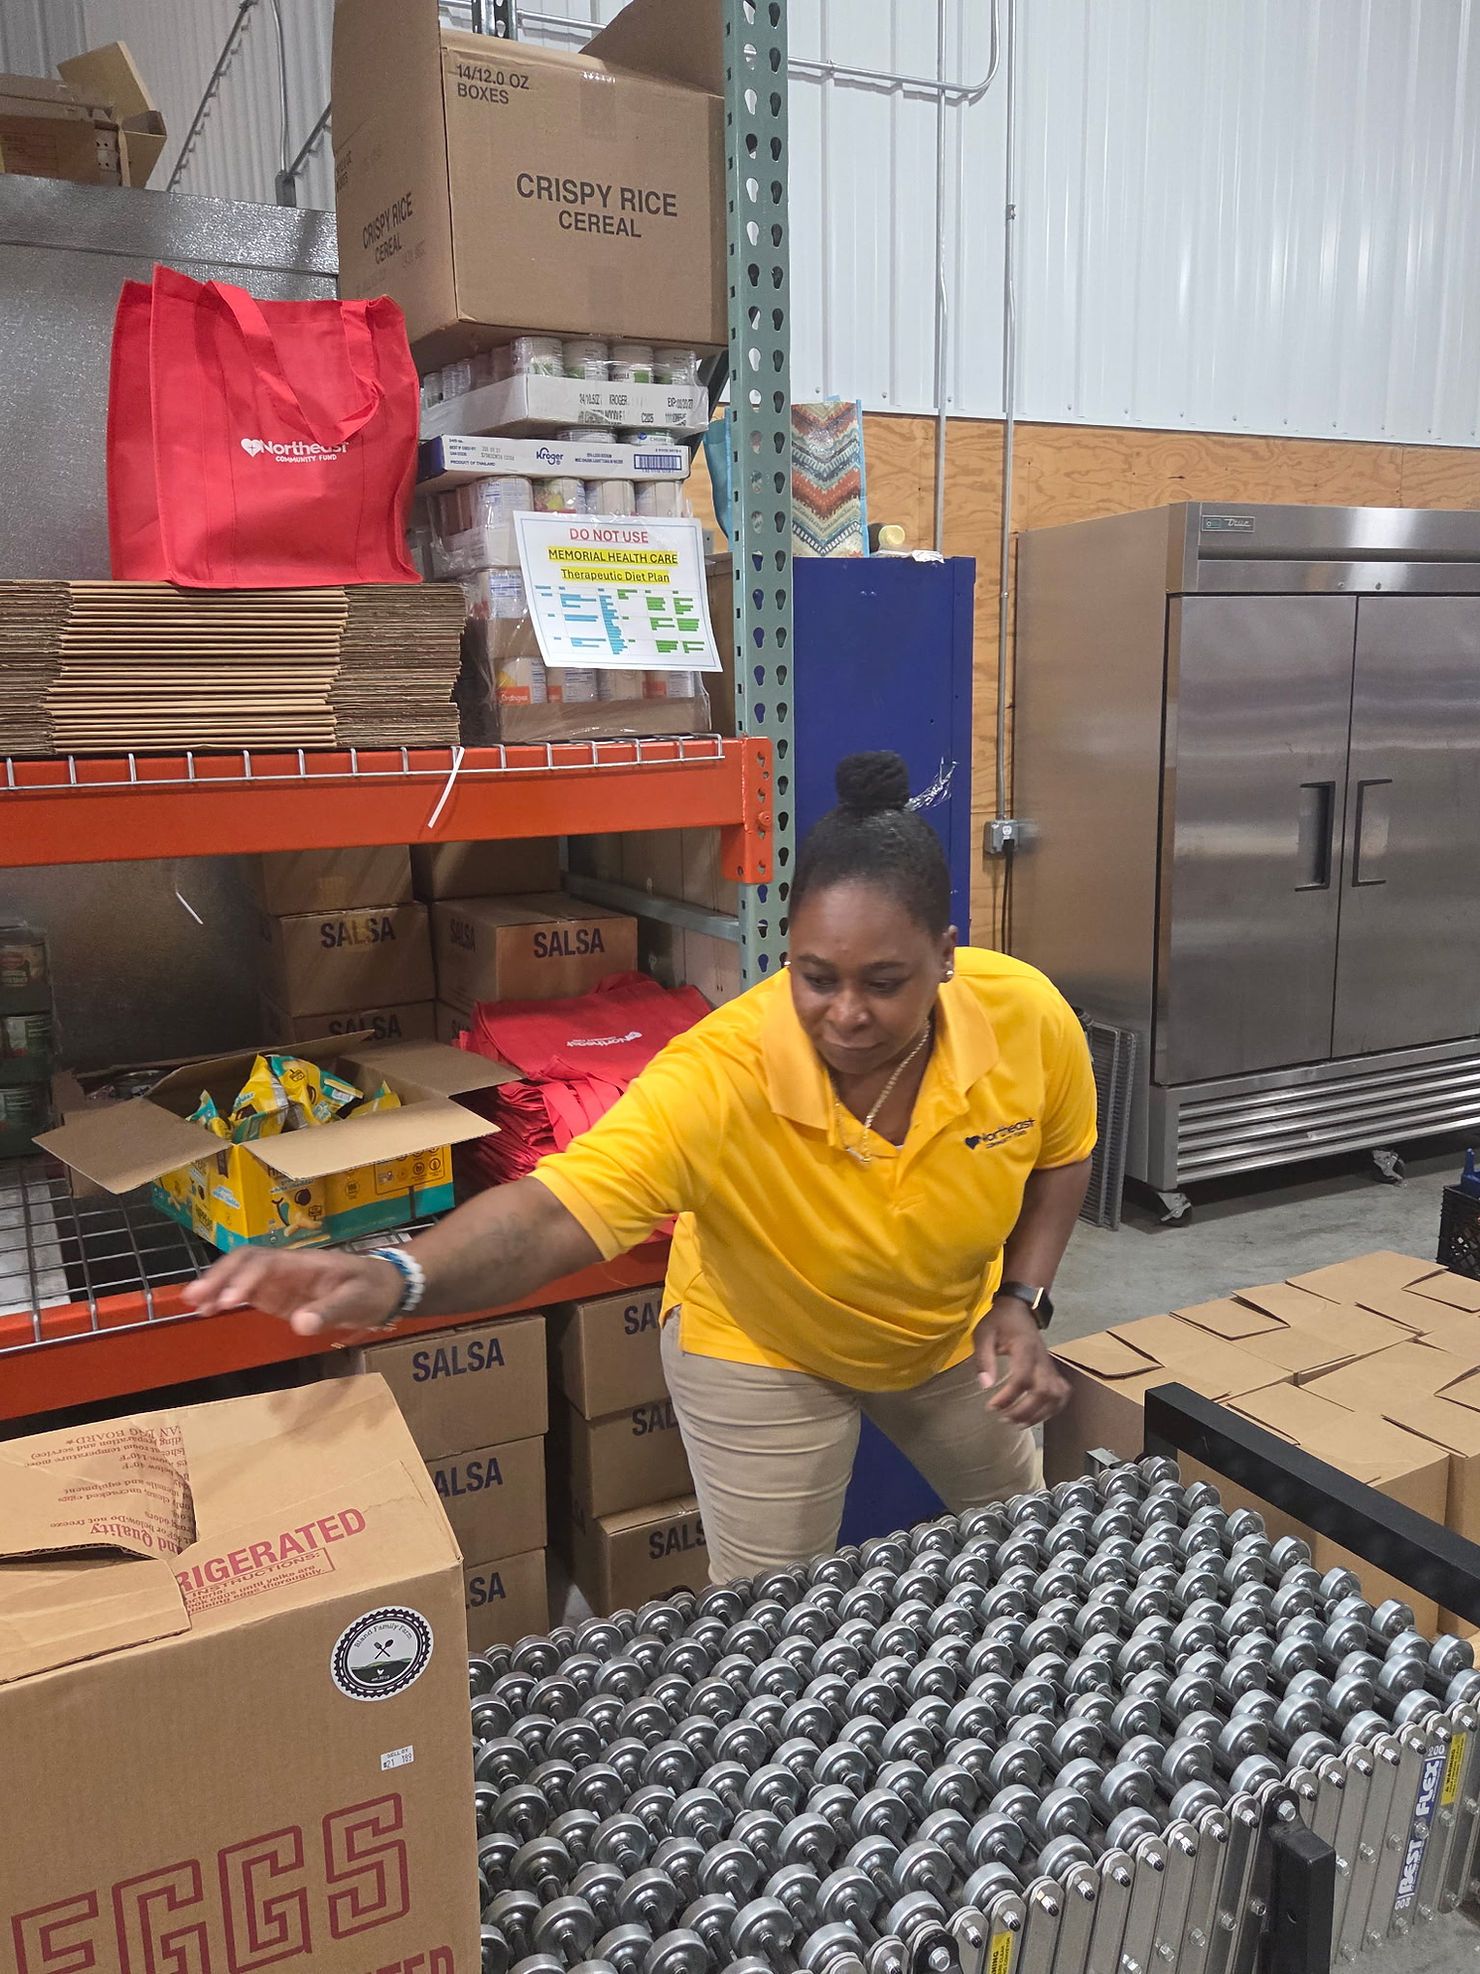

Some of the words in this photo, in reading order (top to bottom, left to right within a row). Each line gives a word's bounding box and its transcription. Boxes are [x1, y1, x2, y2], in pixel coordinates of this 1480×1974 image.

[456, 63, 504, 86] 14/12.0
[509, 72, 530, 91] OZ
[457, 83, 510, 105] BOXES
[516, 172, 613, 210] CRISPY
[620, 186, 678, 218] RICE
[362, 208, 391, 250] CRISPY
[391, 192, 414, 233] RICE
[558, 210, 642, 239] CEREAL
[374, 233, 403, 265] CEREAL
[275, 455, 316, 463] COMMUNITY
[318, 454, 337, 462] FUND
[536, 447, 564, 465] Kroger
[569, 528, 591, 541] DO
[593, 529, 620, 543] NOT
[621, 530, 649, 543] USE
[548, 548, 606, 563] MEMORIAL
[608, 551, 649, 564] HEALTH
[650, 553, 678, 564] CARE
[561, 569, 624, 583] Therapeutic
[625, 569, 643, 582] Diet
[643, 571, 670, 583] Plan
[320, 915, 396, 948] SALSA
[448, 917, 477, 953] SALSA
[533, 927, 605, 958] SALSA
[411, 1337, 505, 1383] SALSA
[631, 1399, 680, 1437] SAL
[55, 1446, 120, 1463] temperature
[77, 1443, 96, 1452] and
[64, 1482, 122, 1495] equipment
[434, 1457, 504, 1498] ALSA
[90, 1523, 153, 1548] Quality
[175, 1507, 367, 1592] RIGERATED
[648, 1518, 707, 1560] SALS
[354, 1629, 373, 1648] Bland
[373, 1622, 399, 1633] Family
[398, 1624, 413, 1640] Farm
[1398, 1839, 1424, 1894] BEST
[1415, 1760, 1440, 1816] FLEX
